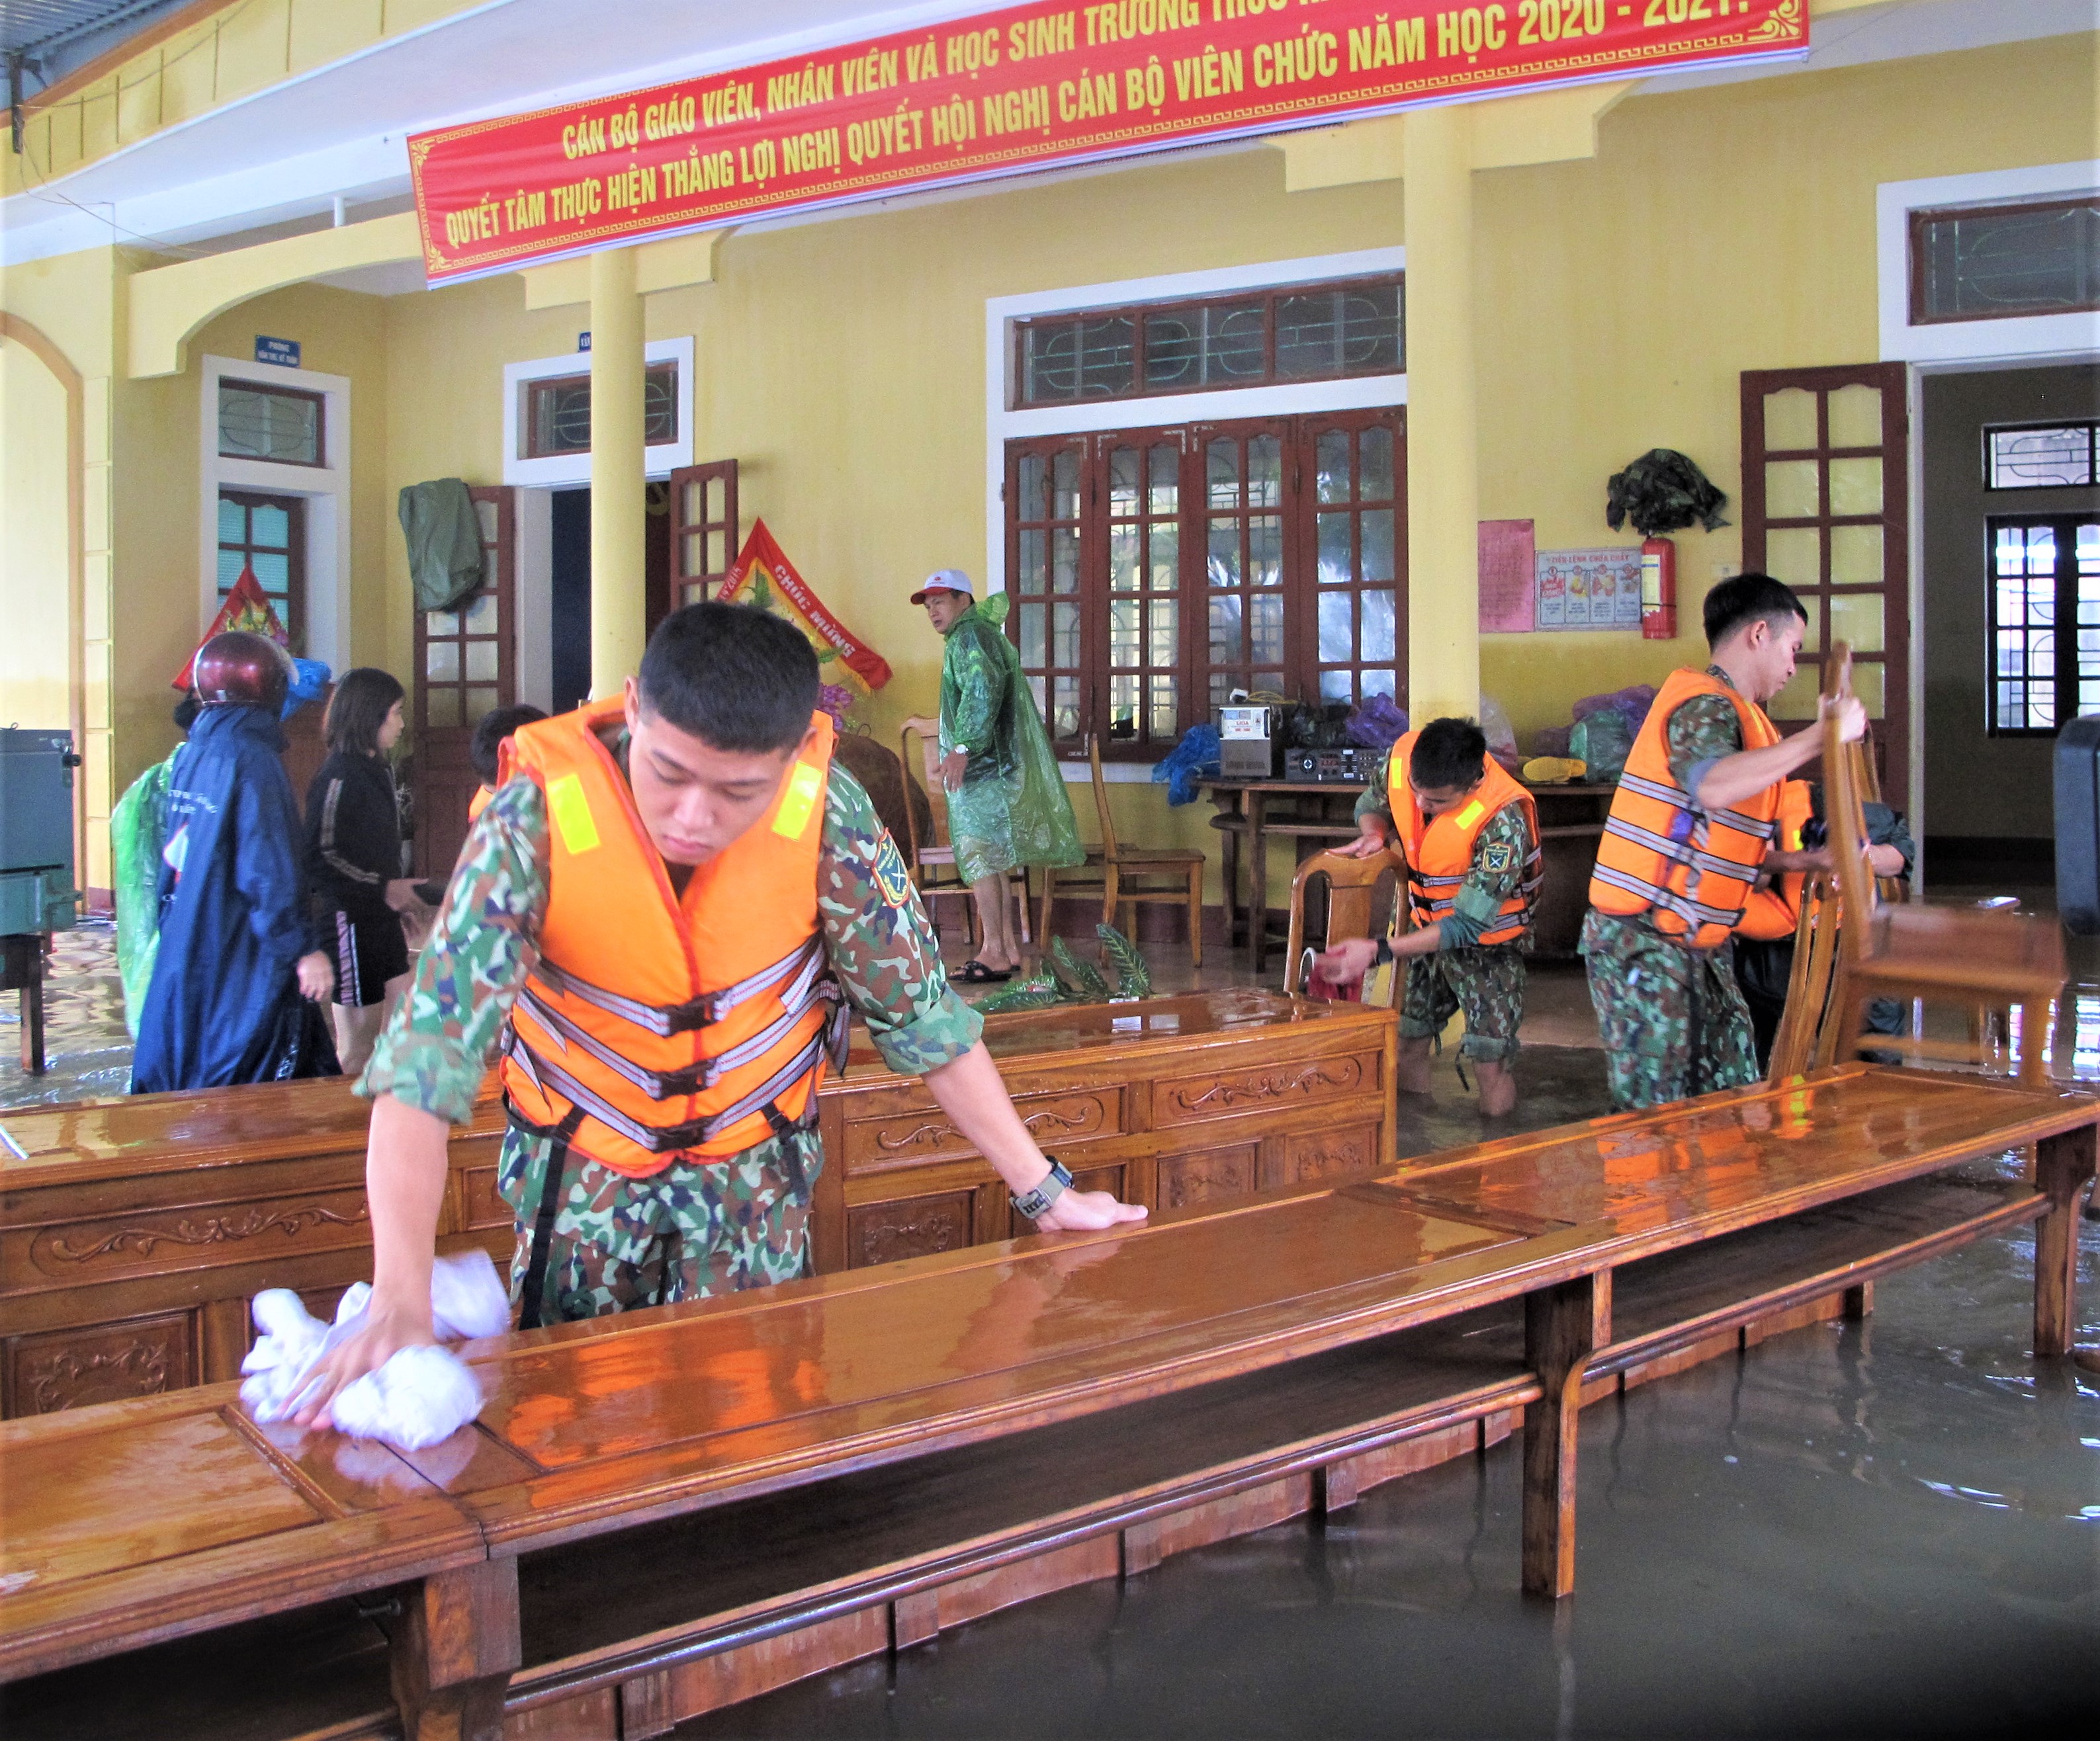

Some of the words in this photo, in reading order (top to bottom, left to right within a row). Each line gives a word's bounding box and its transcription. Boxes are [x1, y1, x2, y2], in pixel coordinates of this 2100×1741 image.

[445, 192, 500, 249] QUYẾT
[505, 189, 547, 233] TÂM
[550, 177, 602, 224] THỰC
[607, 163, 656, 214] HIỆN
[739, 139, 777, 189] LỢI
[781, 128, 841, 175] NGHỊ
[848, 99, 923, 165] QUYẾT
[932, 94, 976, 151] HỘI
[983, 85, 1051, 136] NGHỊ
[1059, 67, 1117, 122] CÁN
[1125, 56, 1165, 116] BỘ
[1173, 45, 1244, 102] VIÊN
[1252, 23, 1338, 89] CHỨC
[1348, 12, 1426, 73] NĂM
[1436, 4, 1507, 64] HỌC
[1518, 0, 1606, 46] 2020
[563, 115, 606, 159] CÁN
[611, 103, 640, 153] BỘ
[644, 93, 695, 142] GIÁO
[702, 79, 761, 128] VIÊN,
[767, 62, 834, 114] NHÂN
[842, 47, 898, 97] VIÊN
[906, 34, 939, 83] VÀ
[946, 28, 1000, 80] HỌC
[1008, 11, 1075, 62] SINH
[775, 564, 811, 610] CHÚC
